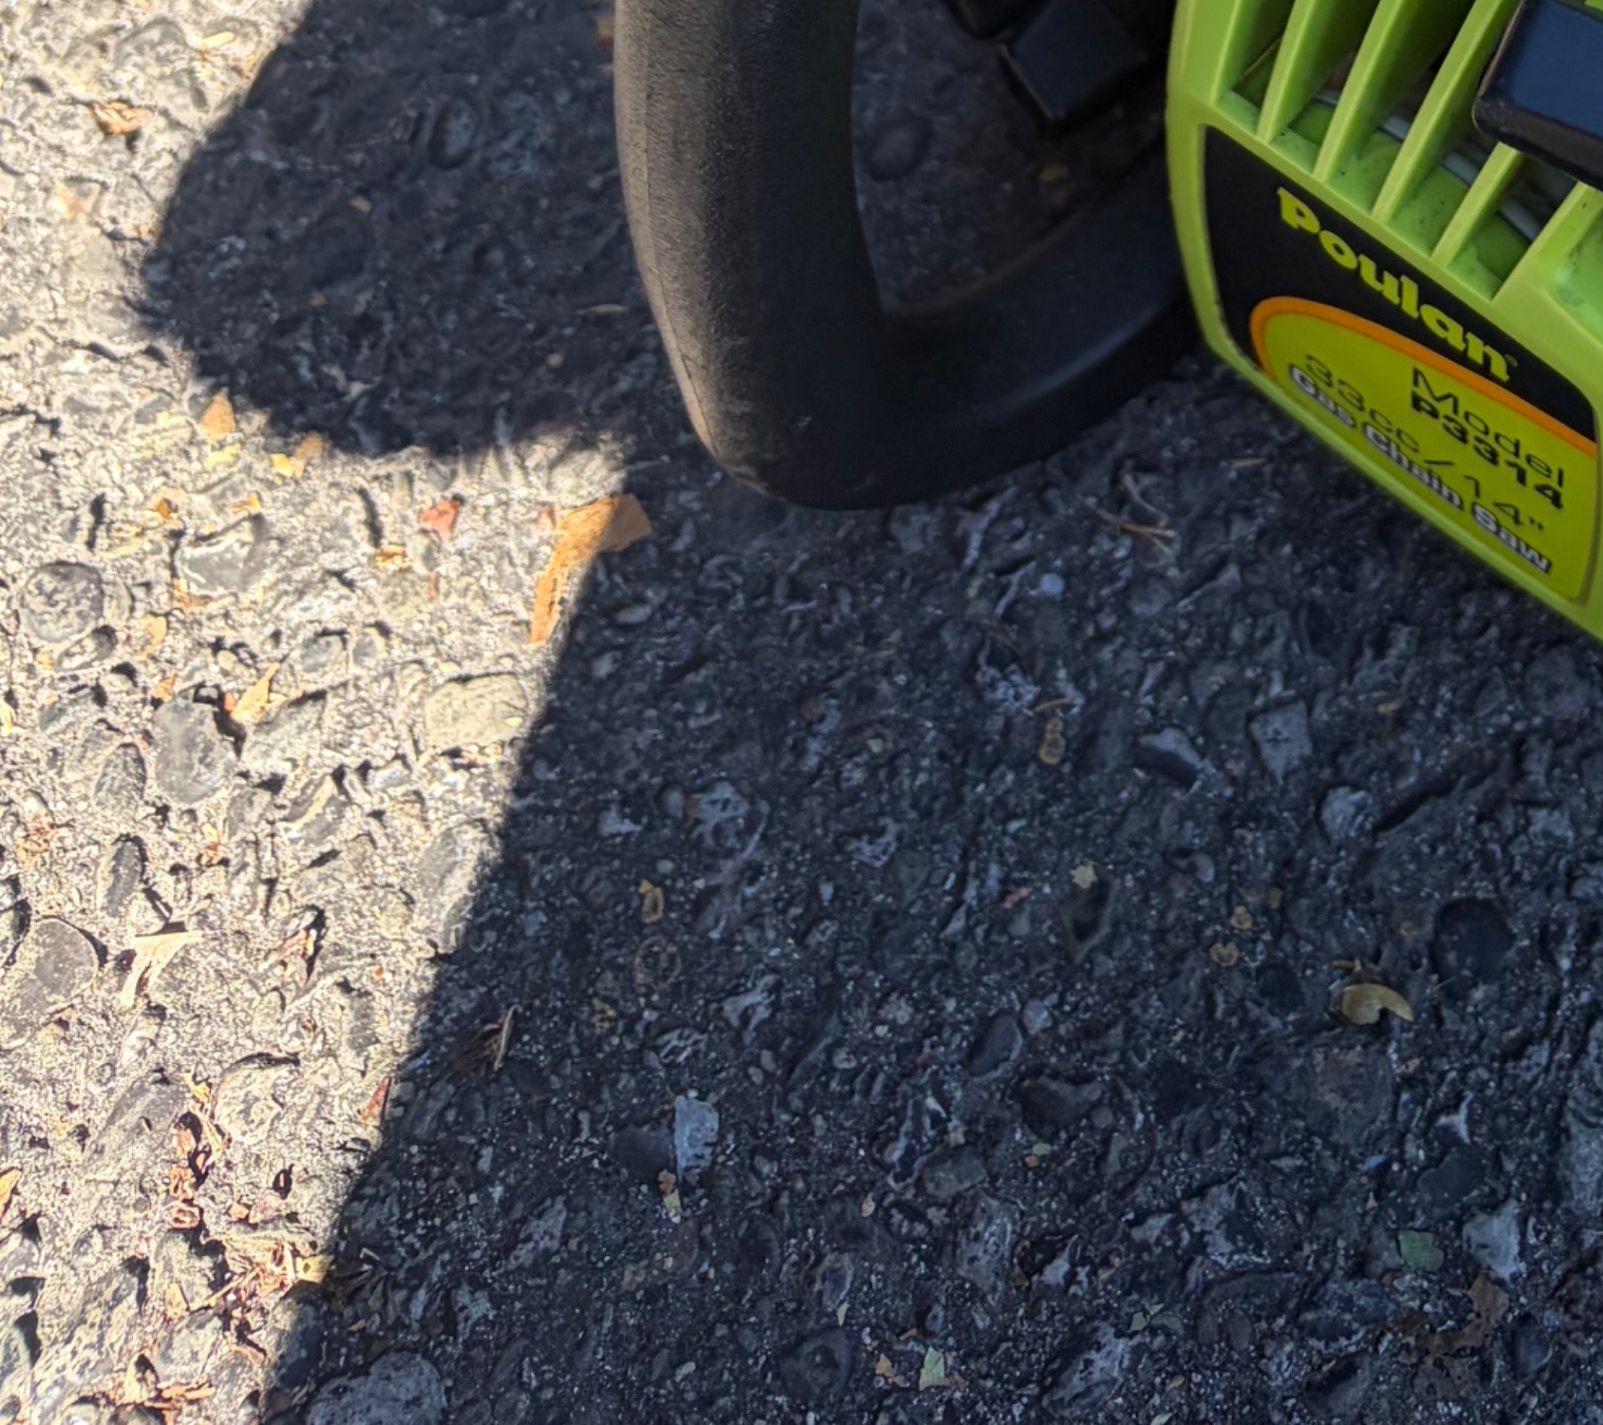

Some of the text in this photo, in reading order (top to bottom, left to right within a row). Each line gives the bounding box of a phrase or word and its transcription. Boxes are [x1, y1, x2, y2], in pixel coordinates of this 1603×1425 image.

[1276, 186, 1510, 383] Poulan
[1289, 362, 1552, 575] Gas Chain Saw
[1409, 389, 1564, 511] P3314
[1412, 366, 1565, 489] Model
